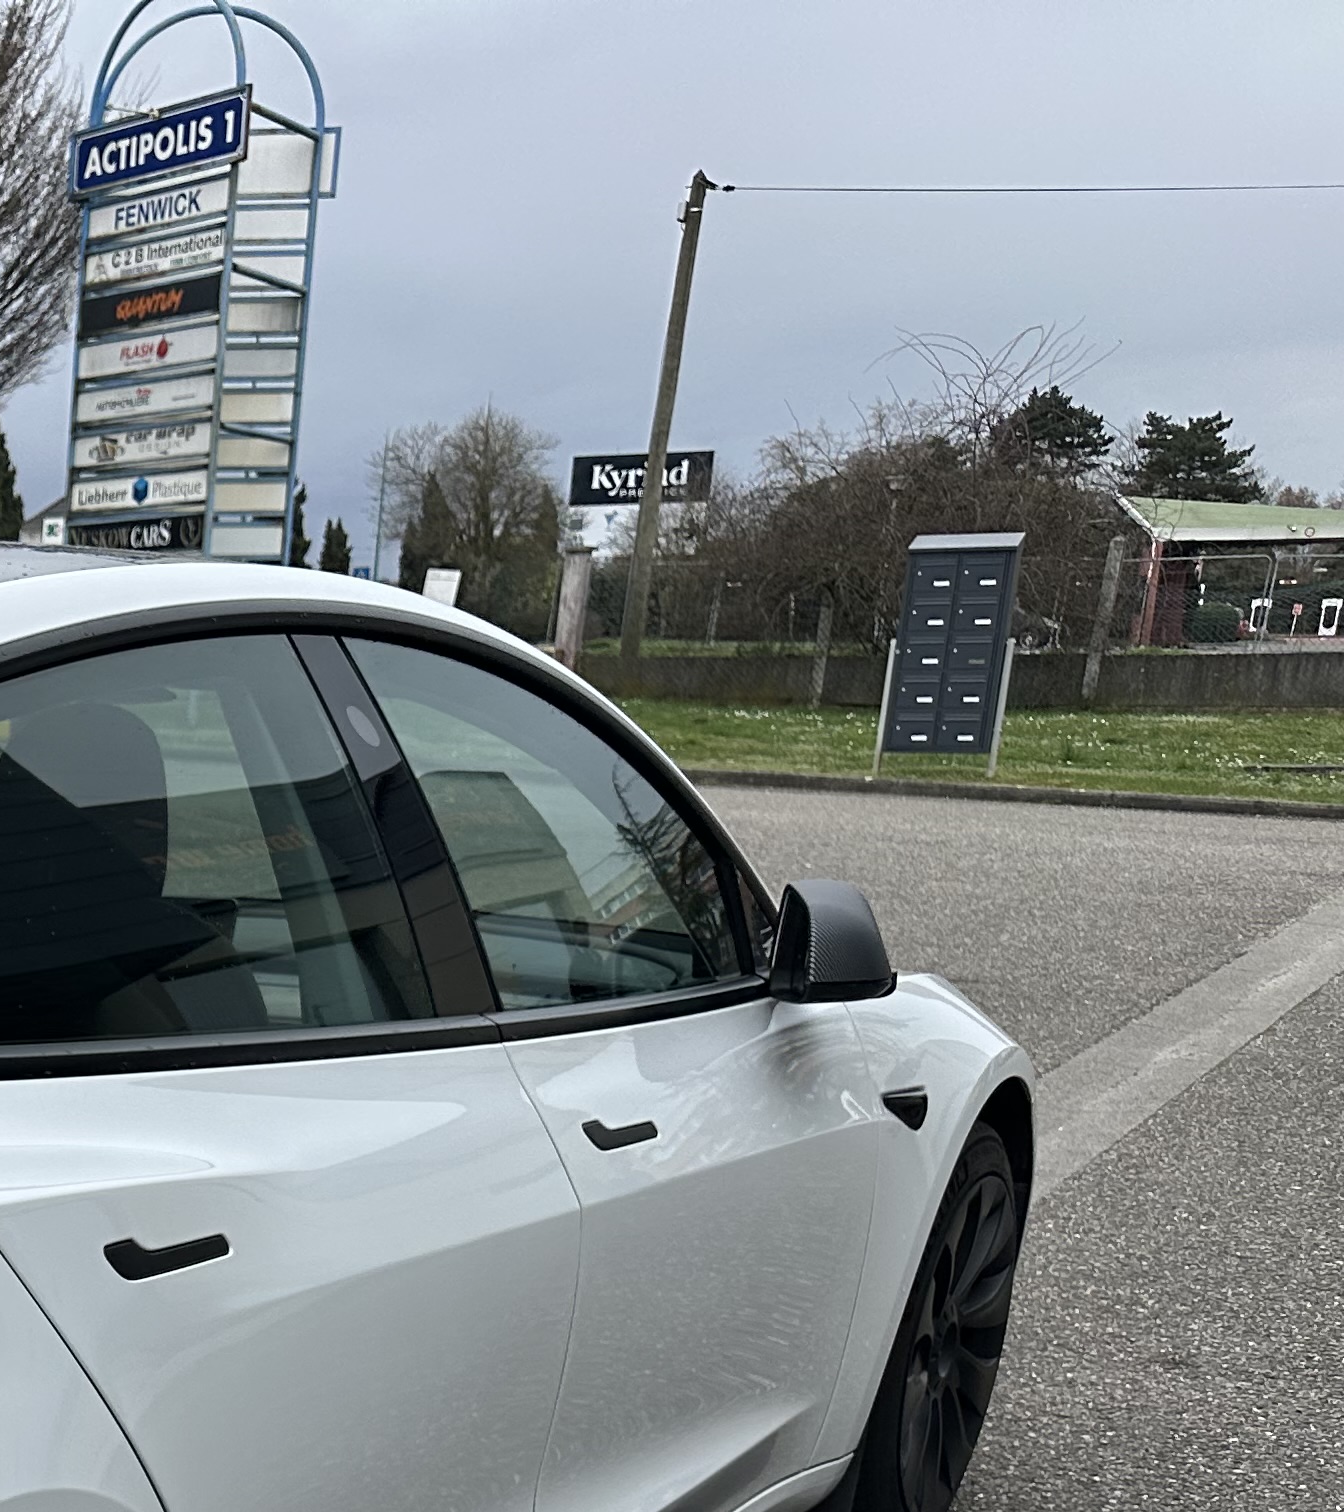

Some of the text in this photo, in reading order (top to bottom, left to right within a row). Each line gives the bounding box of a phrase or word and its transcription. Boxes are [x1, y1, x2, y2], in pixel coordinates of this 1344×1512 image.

[83, 110, 235, 180] ACTIPOLIS 1
[114, 189, 203, 230] FENWICK
[111, 250, 121, 269] C
[146, 229, 224, 262] International
[152, 478, 203, 498] Plastique
[130, 518, 172, 549] CARS
